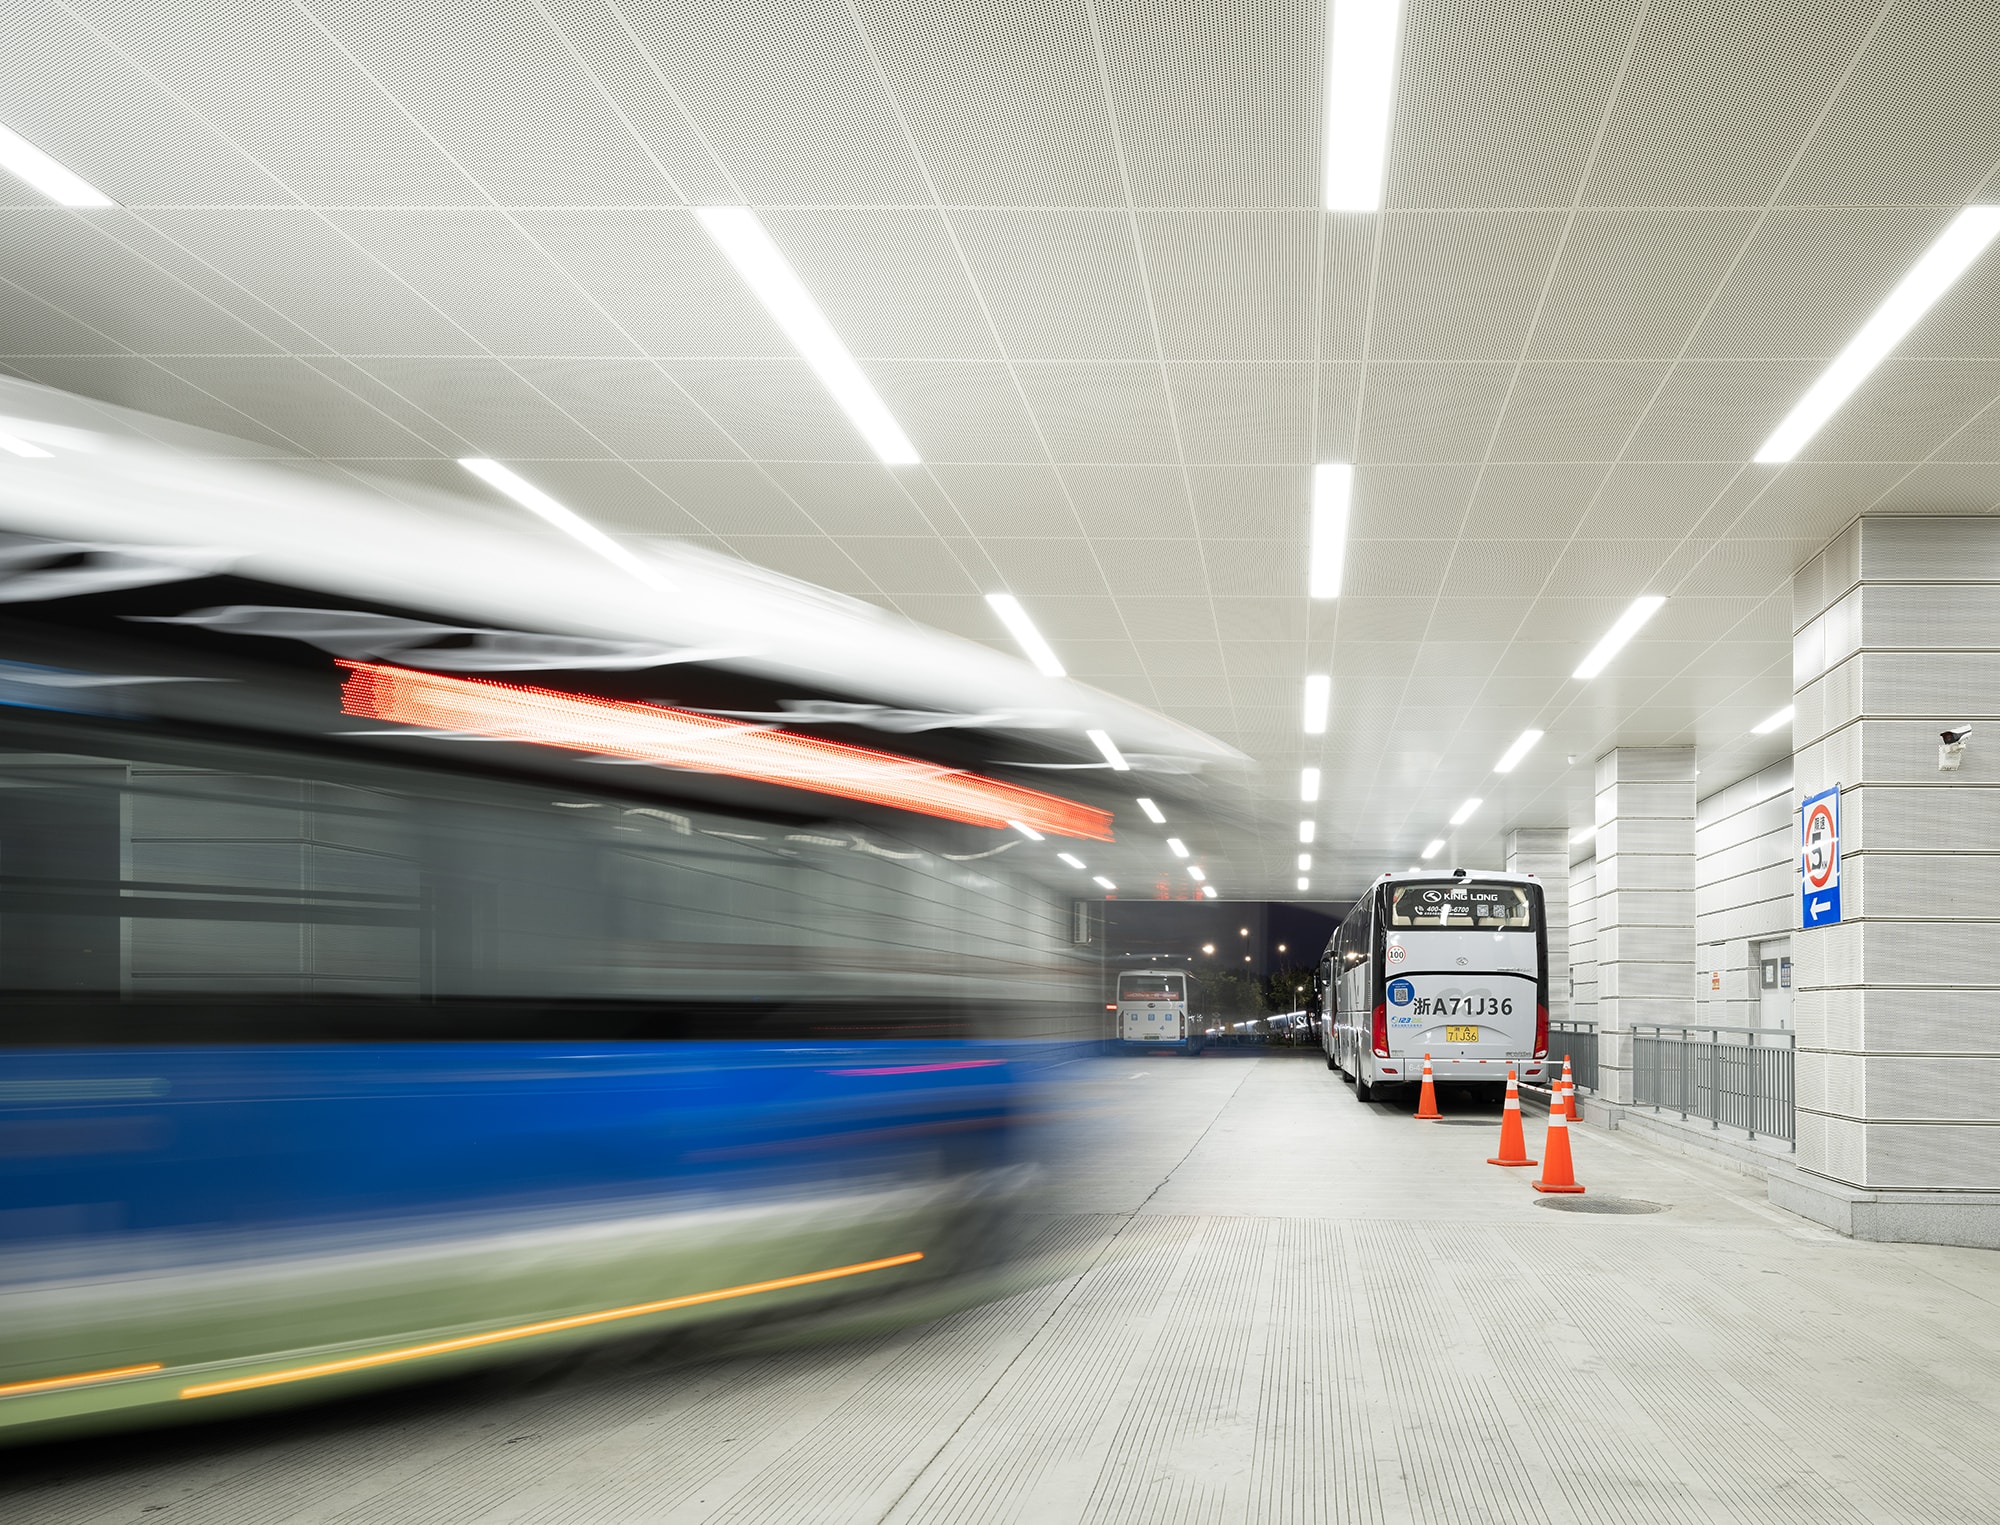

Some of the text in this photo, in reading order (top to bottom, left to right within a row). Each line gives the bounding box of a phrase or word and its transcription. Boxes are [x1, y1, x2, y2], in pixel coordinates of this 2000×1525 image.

[1812, 831, 1822, 870] 5
[1470, 893, 1498, 901] LONG
[1390, 951, 1404, 959] 100
[1413, 997, 1513, 1016] 浙A71J36
[1448, 1031, 1477, 1042] 71J36
